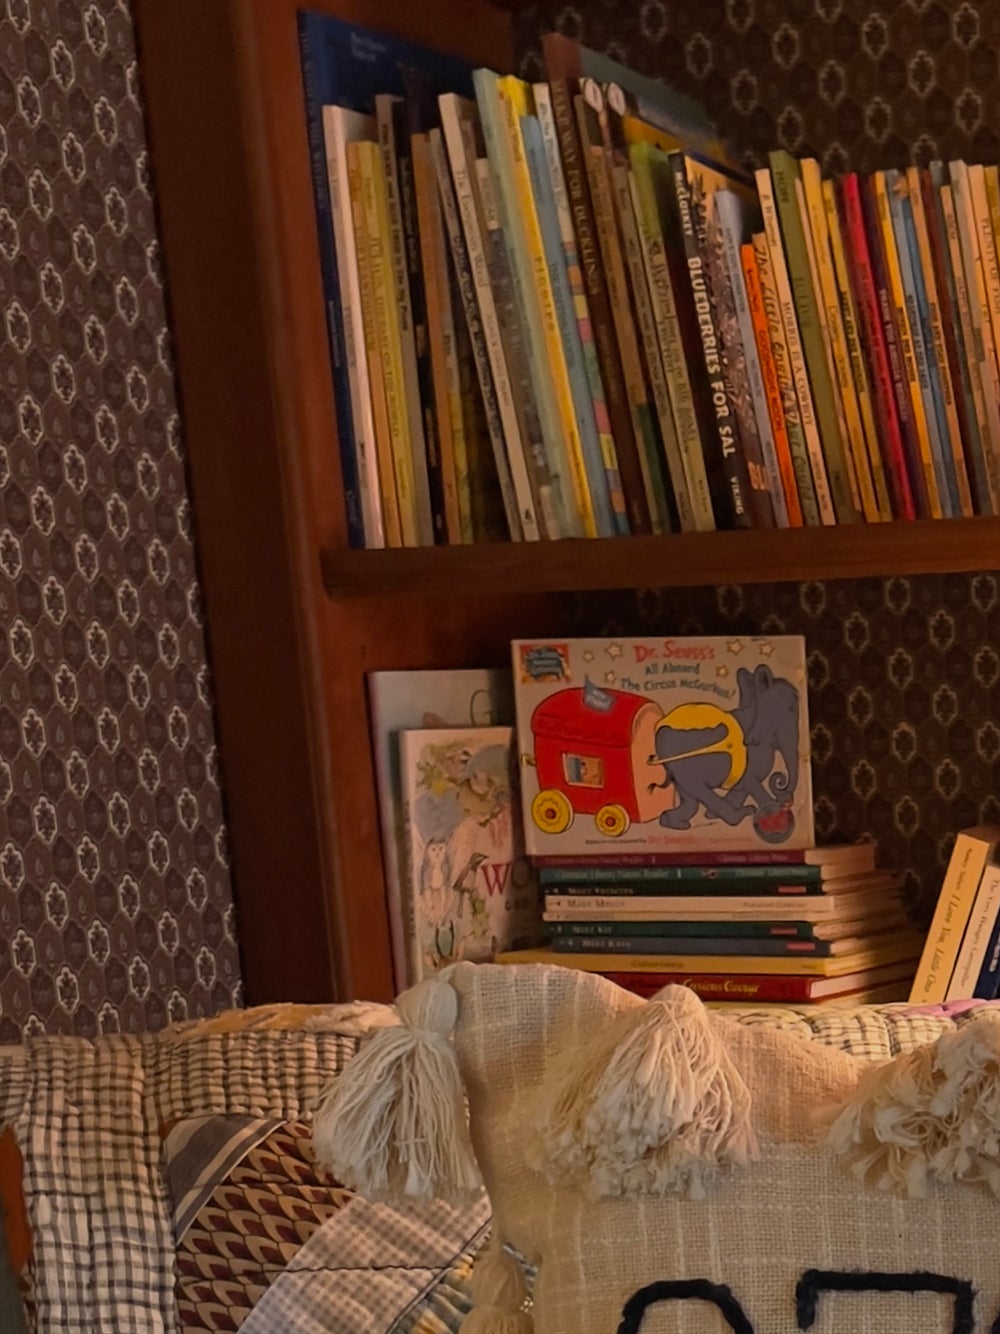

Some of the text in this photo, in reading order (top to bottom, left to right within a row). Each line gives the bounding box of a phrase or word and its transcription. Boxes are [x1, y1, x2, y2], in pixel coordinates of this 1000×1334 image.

[549, 79, 570, 127] MAKE
[559, 129, 577, 164] WAY
[567, 167, 584, 199] FOR
[574, 203, 603, 294] DUCKLINGS
[753, 245, 770, 277] The
[981, 217, 995, 263] PLENTY
[990, 266, 998, 280] OF
[760, 280, 783, 332] Little
[782, 300, 812, 427] MORRIS IS A COWBOY
[709, 379, 730, 419] FOR
[718, 424, 736, 457] SAL
[633, 645, 658, 662] Dr.
[645, 663, 701, 675] All Aboard
[621, 678, 641, 692] The
[644, 679, 677, 692] Circus
[988, 877, 1000, 893] The
[943, 900, 959, 924] Love
[971, 913, 988, 944] Hungry
[928, 946, 945, 972] Little
[921, 972, 937, 993] One
